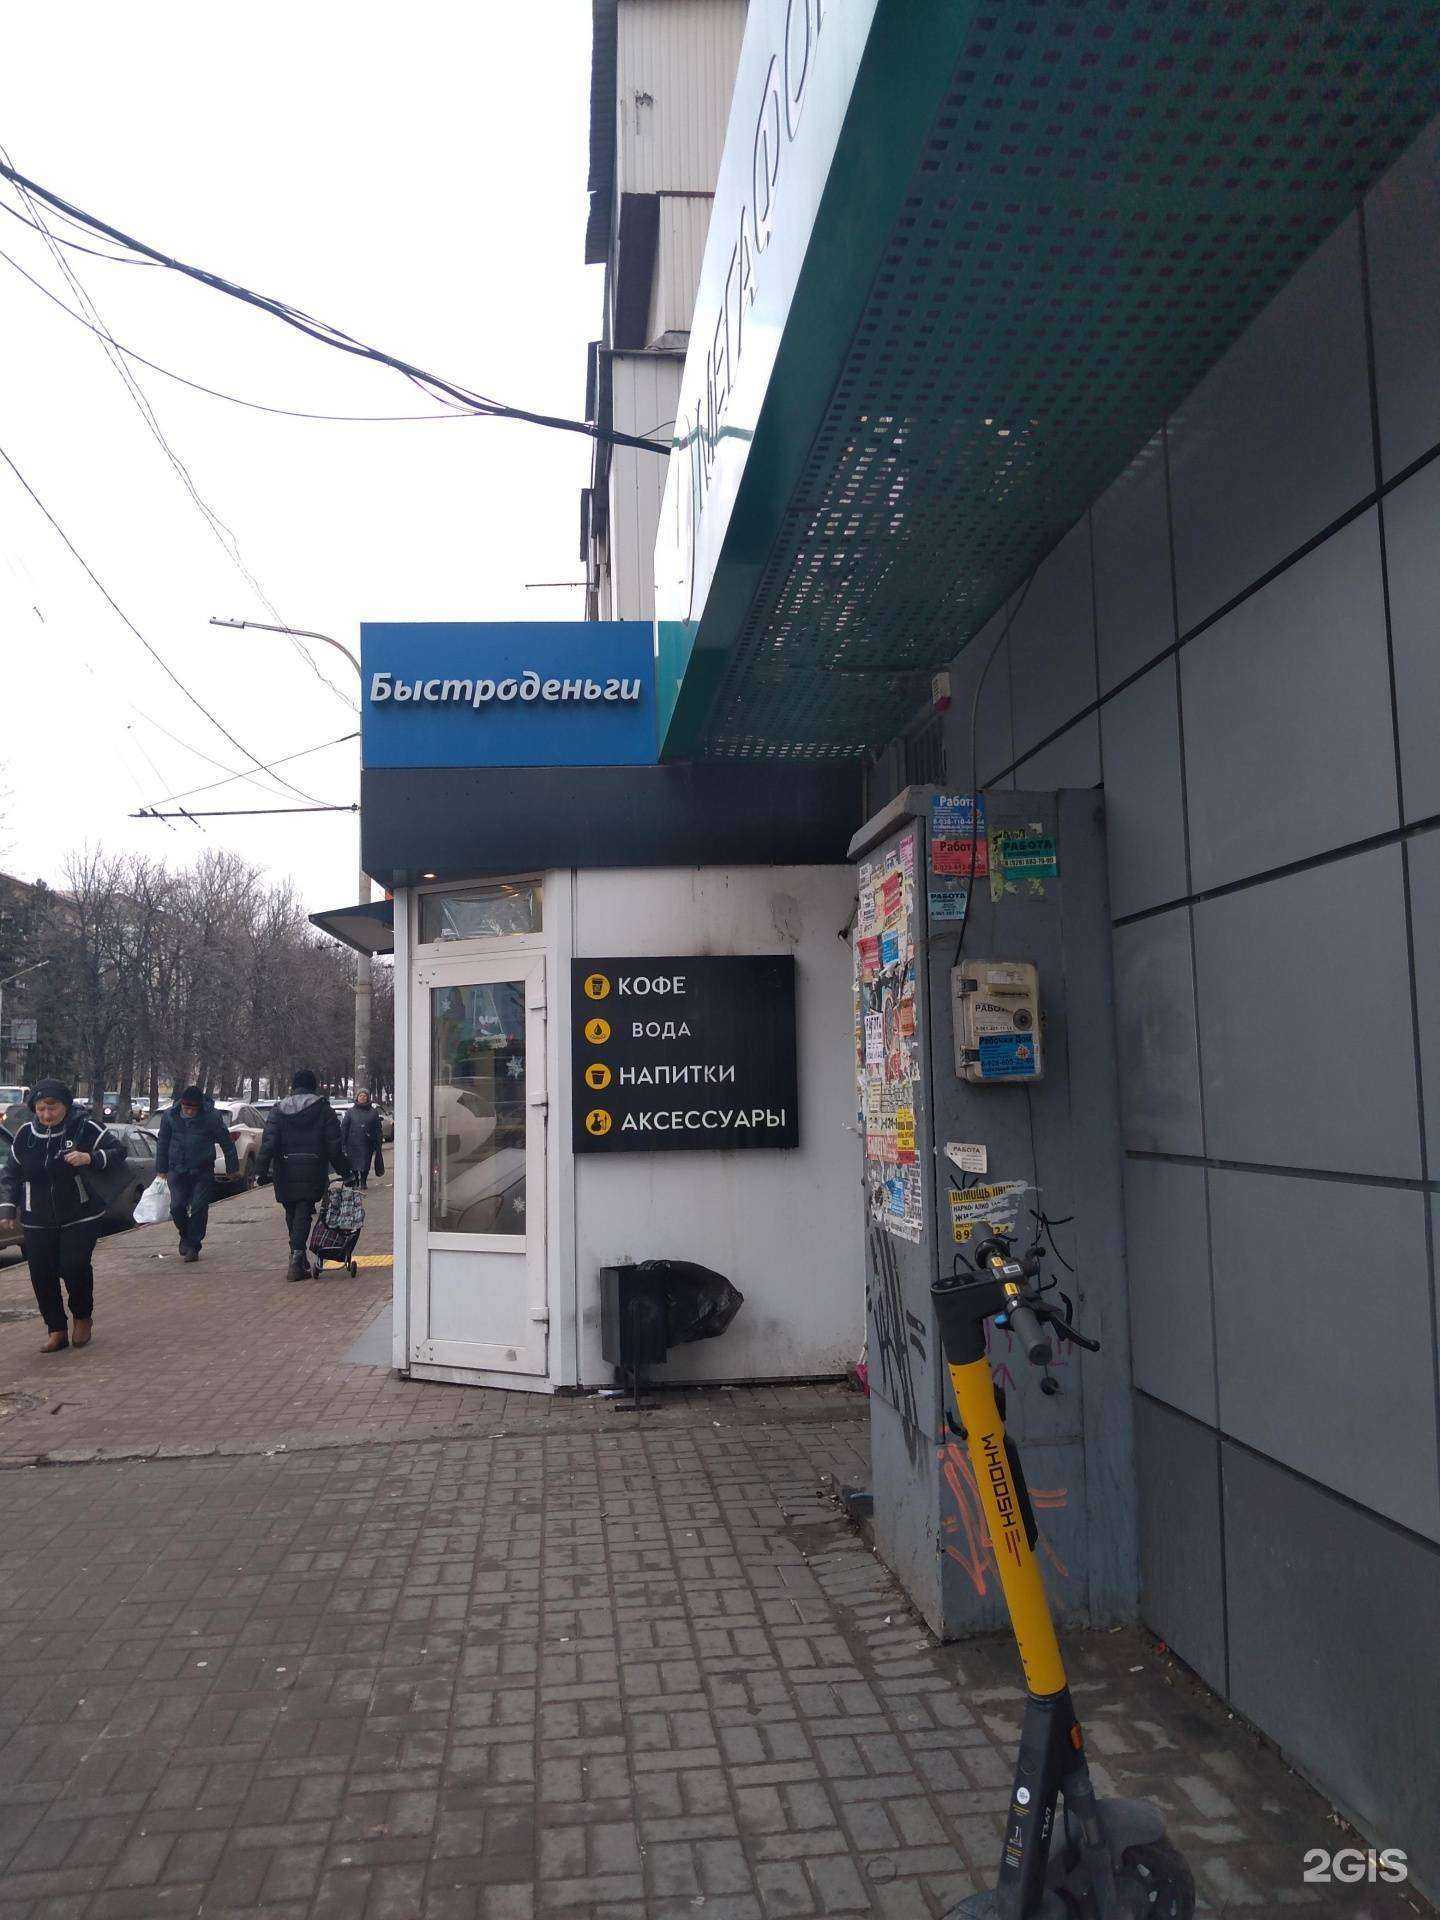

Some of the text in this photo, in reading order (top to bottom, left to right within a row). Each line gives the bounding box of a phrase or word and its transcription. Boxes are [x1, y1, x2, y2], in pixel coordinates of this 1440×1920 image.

[369, 670, 641, 708] Быстроденьги
[1003, 839, 1053, 851] РАБОТА
[618, 976, 686, 995] КОФЕ
[632, 1021, 691, 1039] ВОДА
[619, 1065, 736, 1085] НАПИТКИ
[621, 1109, 786, 1131] АКСЕССУАРЫ
[981, 1433, 1017, 1528] WHOOSH
